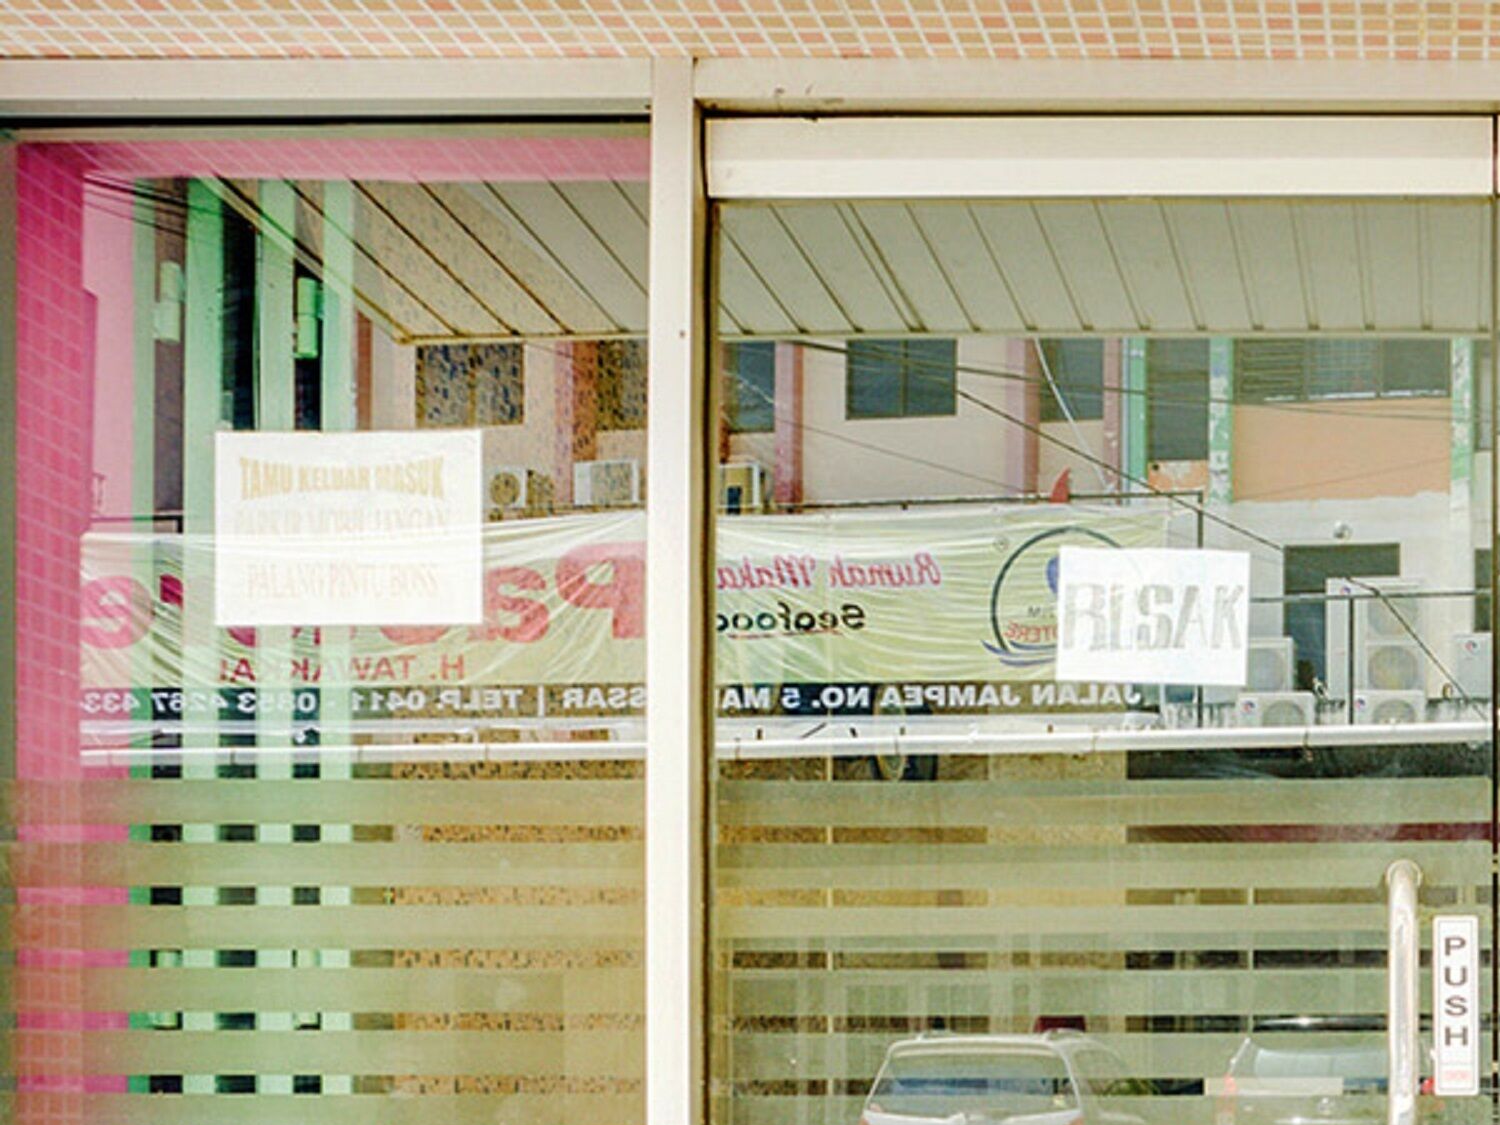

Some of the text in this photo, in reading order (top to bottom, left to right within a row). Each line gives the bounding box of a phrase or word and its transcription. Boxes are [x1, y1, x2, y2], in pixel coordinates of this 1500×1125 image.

[240, 456, 445, 500] TAMU KELUAR MASUK
[1444, 935, 1469, 1047] PUSH
